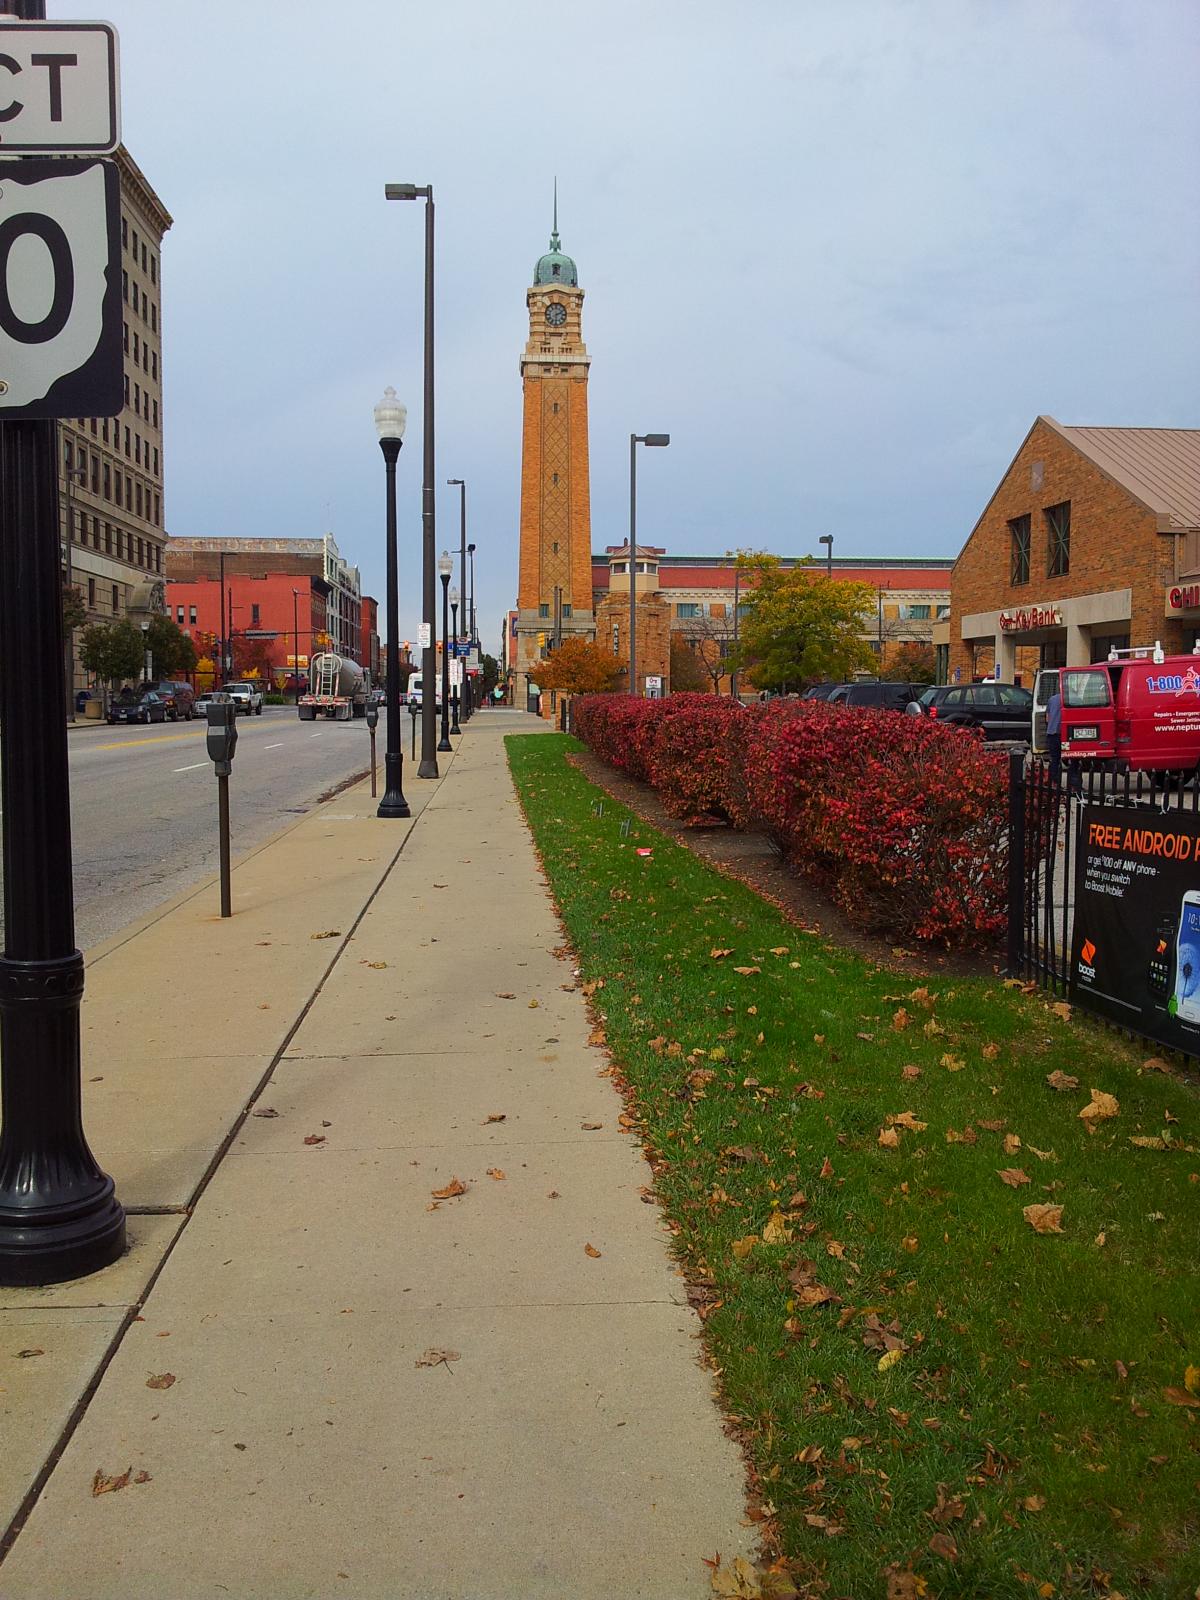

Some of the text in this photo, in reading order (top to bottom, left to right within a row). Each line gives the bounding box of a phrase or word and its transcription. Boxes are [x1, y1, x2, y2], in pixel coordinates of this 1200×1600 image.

[1016, 605, 1057, 631] KeyBank
[1089, 824, 1121, 849] FREE
[1088, 856, 1093, 864] or
[1094, 857, 1102, 867] get
[1113, 859, 1122, 870] off
[1122, 861, 1137, 872] ANY
[1137, 864, 1156, 876] phone
[1087, 868, 1131, 885] when you switch
[1092, 880, 1105, 893] Boost
